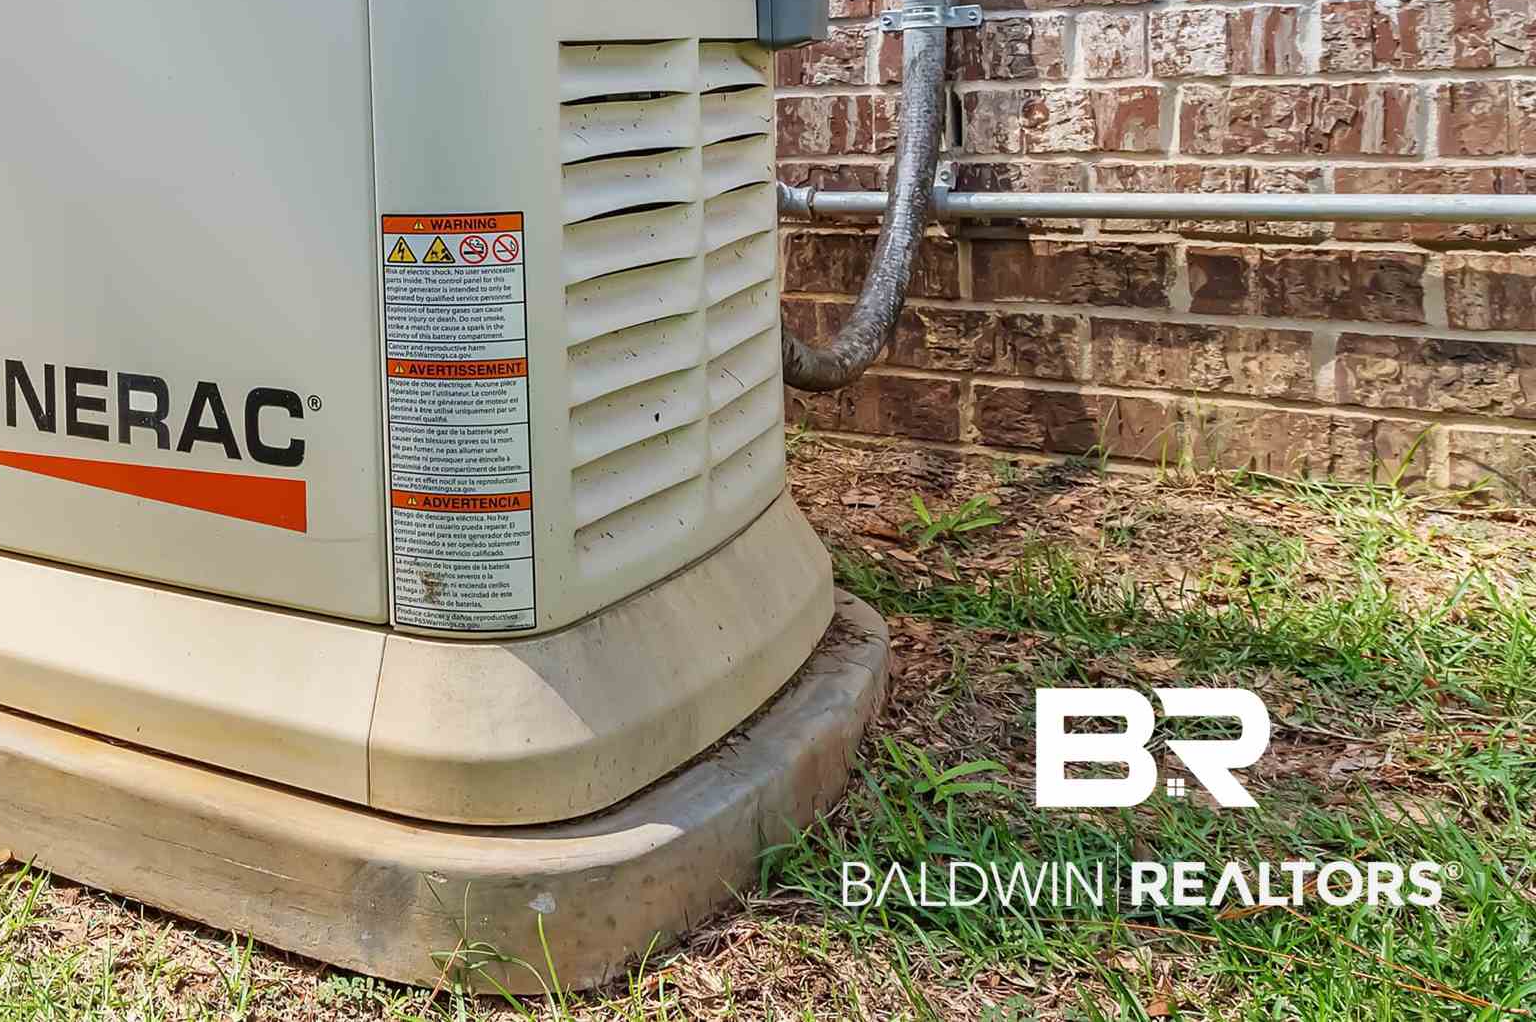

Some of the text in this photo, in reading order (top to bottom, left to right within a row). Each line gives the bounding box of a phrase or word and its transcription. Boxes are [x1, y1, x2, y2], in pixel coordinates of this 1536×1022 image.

[431, 217, 497, 229] WARNING
[409, 362, 522, 377] AVERTISSEMENT
[423, 497, 521, 509] ADVERTENCIA
